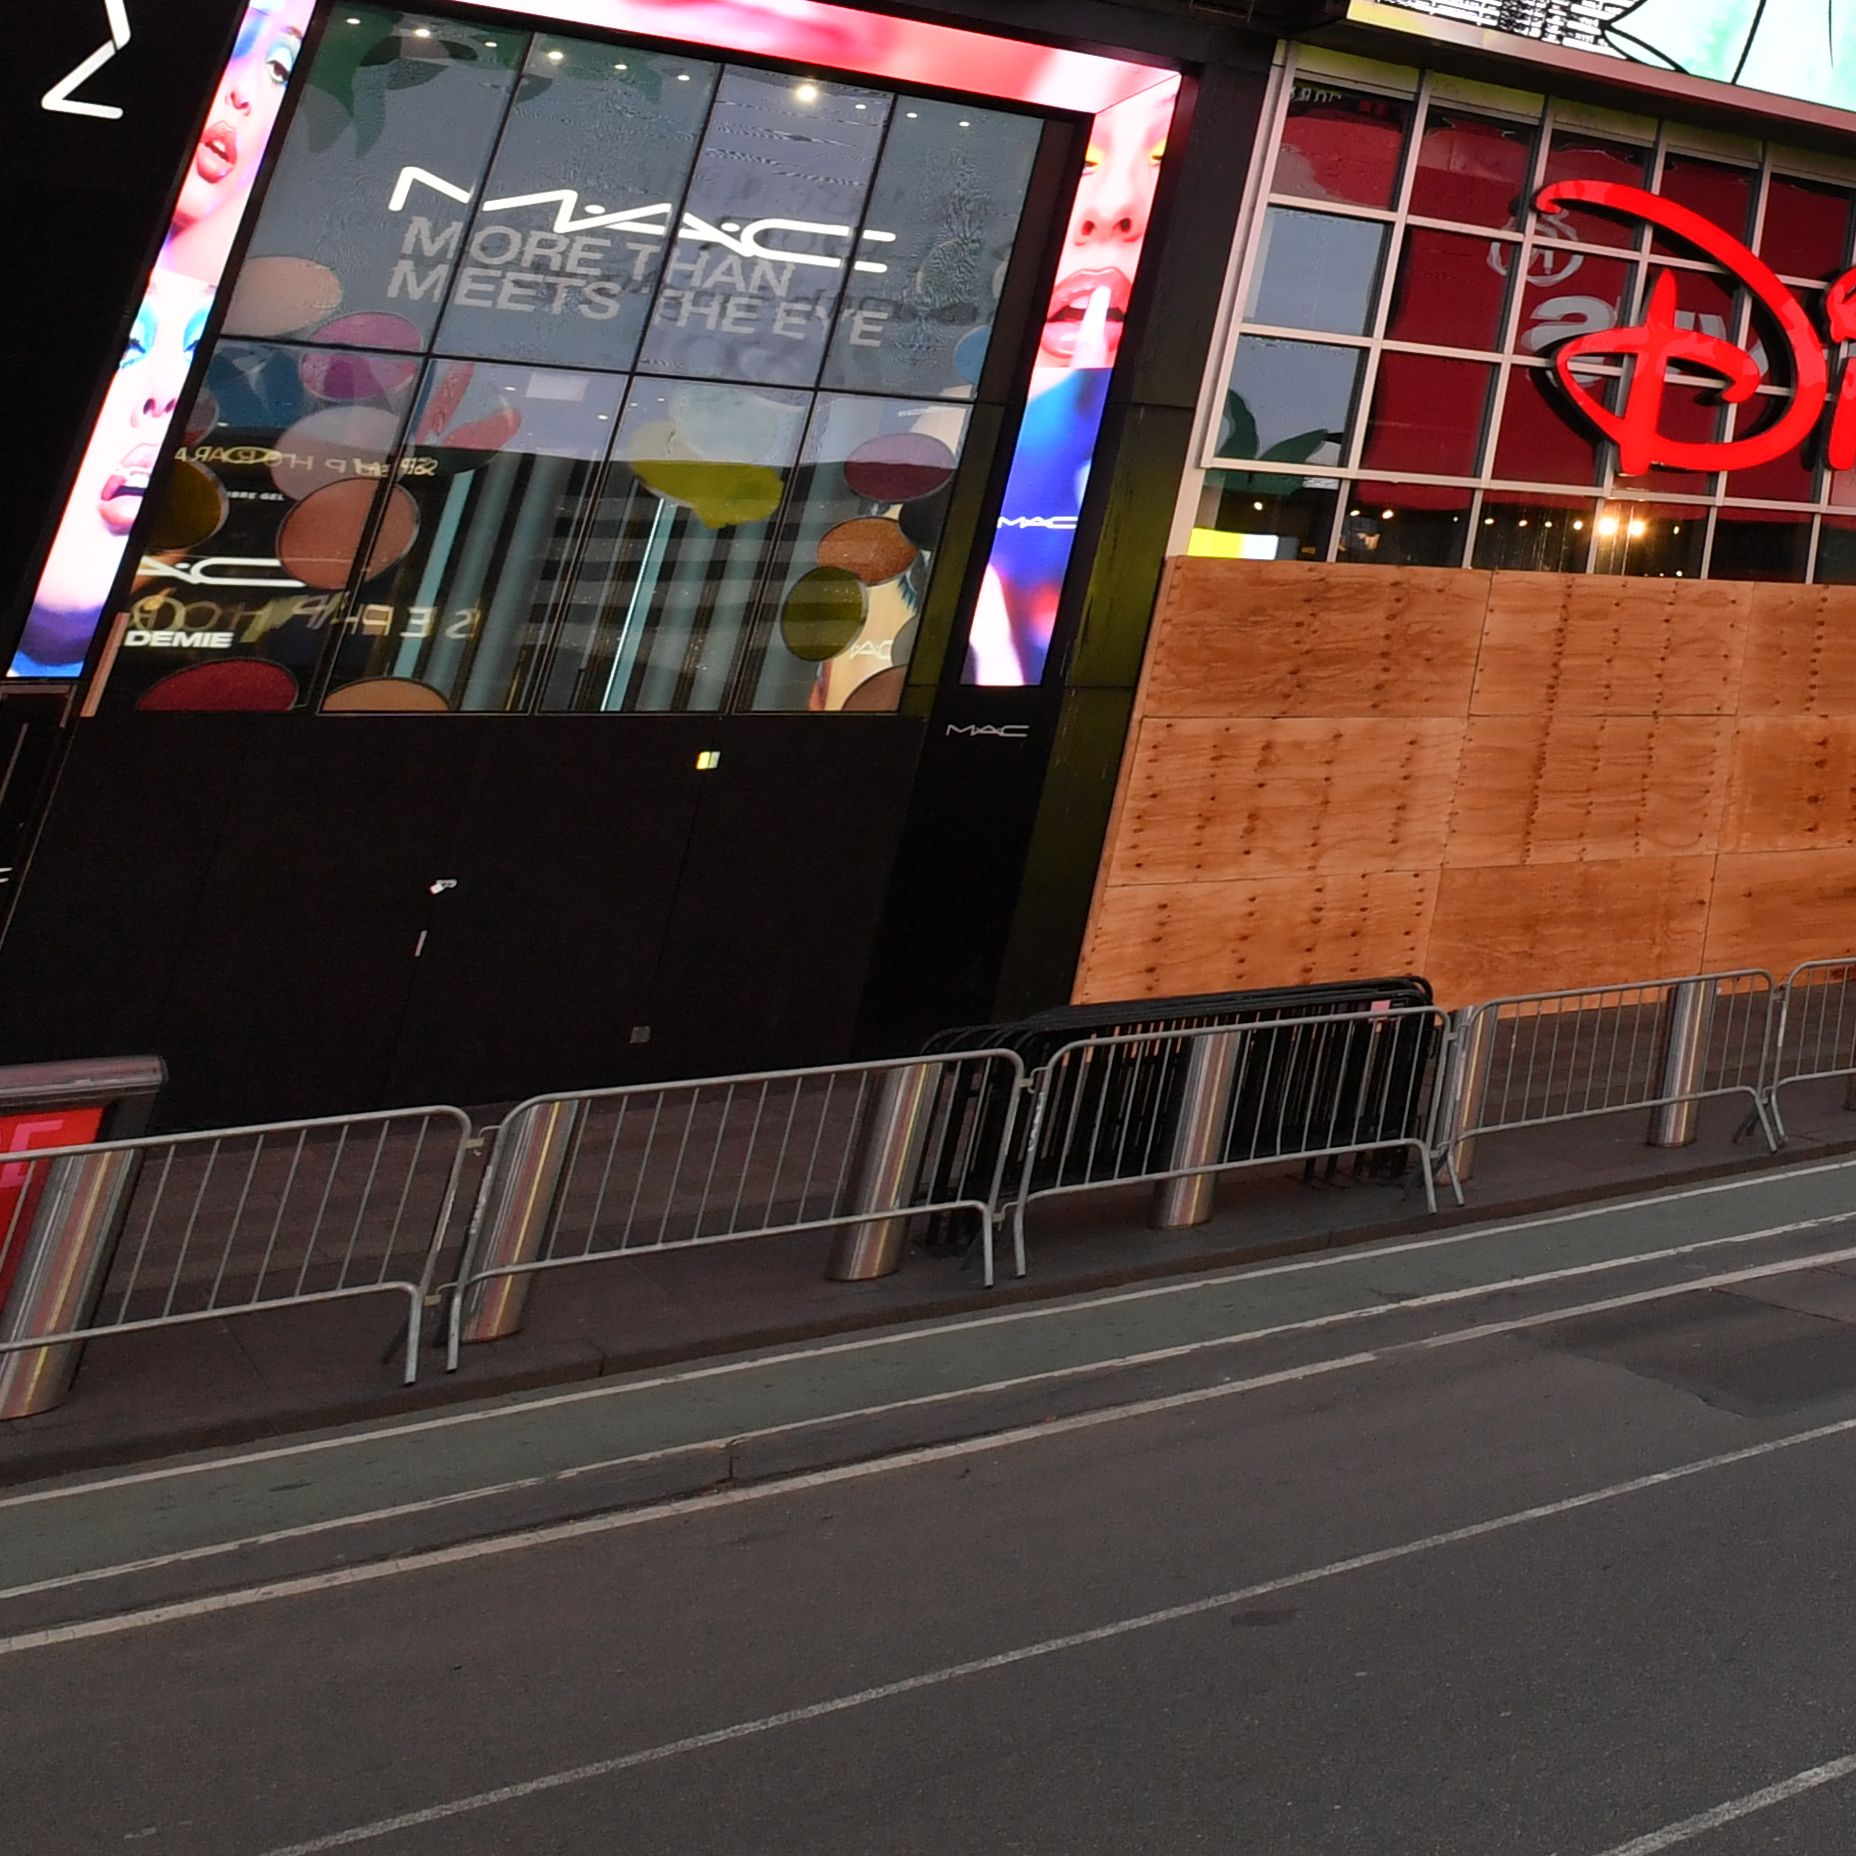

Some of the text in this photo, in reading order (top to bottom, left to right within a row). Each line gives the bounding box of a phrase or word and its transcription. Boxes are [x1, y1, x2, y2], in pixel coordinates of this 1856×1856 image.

[402, 214, 796, 297] MORE THAN
[386, 259, 889, 348] MEETS THE EYE
[260, 491, 285, 501] GEL
[997, 515, 1079, 530] MAC
[124, 629, 233, 649] DEMIE
[945, 724, 1031, 738] MAC
